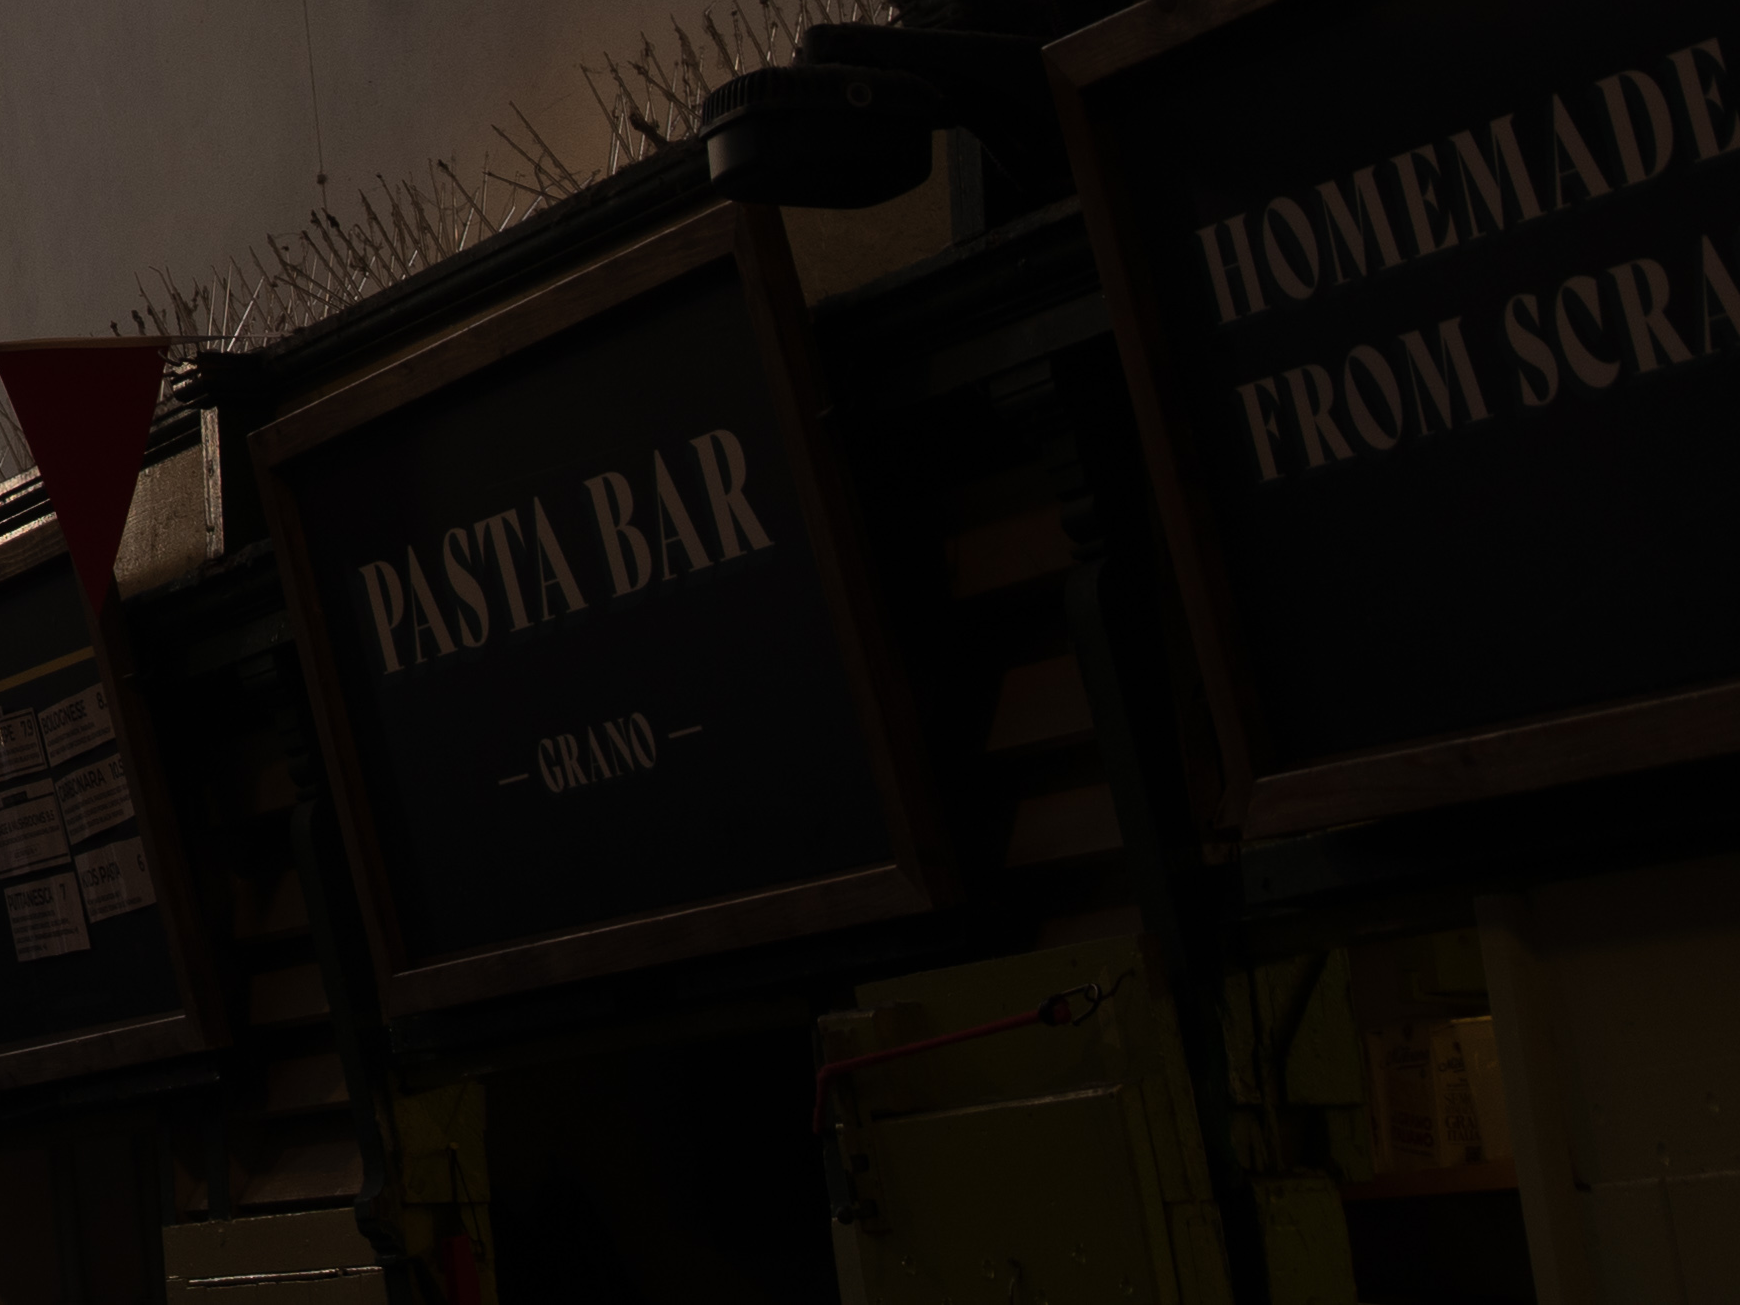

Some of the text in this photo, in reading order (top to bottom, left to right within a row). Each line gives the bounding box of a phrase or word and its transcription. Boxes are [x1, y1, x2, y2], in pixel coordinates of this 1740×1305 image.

[1195, 36, 1740, 326] HOMEMADE
[1236, 316, 1494, 484] FROM
[359, 428, 775, 676] PASTA BAR
[40, 698, 87, 735] BOLOGNESE
[537, 710, 658, 794] GRANO
[57, 764, 107, 805] CARBONARA
[135, 852, 145, 872] 6
[6, 882, 67, 912] PUTTANESCA 7
